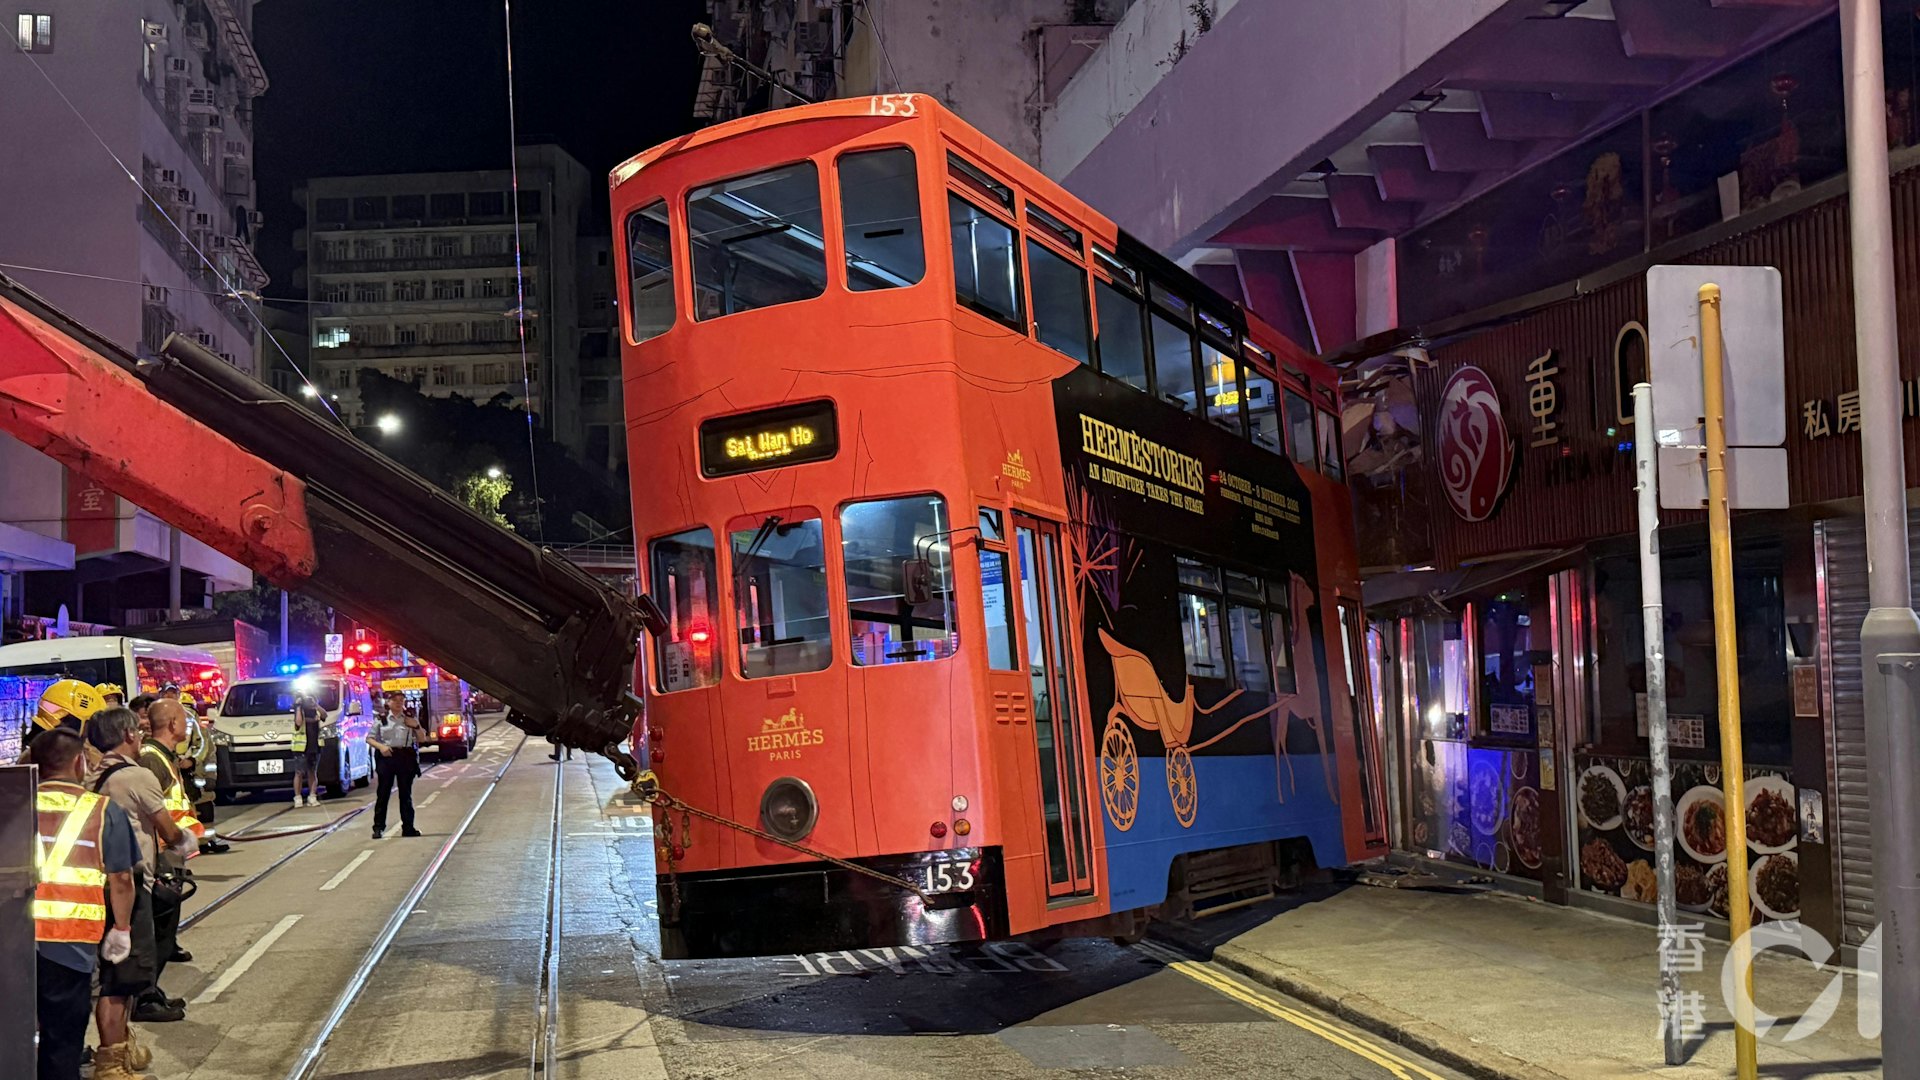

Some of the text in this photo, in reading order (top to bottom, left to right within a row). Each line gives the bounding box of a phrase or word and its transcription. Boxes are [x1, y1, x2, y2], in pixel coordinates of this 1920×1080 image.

[870, 93, 916, 117] 153
[726, 437, 754, 457] Sai
[758, 433, 787, 451] Wan
[790, 426, 814, 445] Ho
[78, 482, 105, 511] 室
[1088, 461, 1100, 481] AN
[1101, 466, 1146, 496] ADVENTURE
[1145, 481, 1169, 504] TAKES
[1169, 490, 1184, 508] THE
[1184, 495, 1205, 516] STAGE
[747, 728, 824, 752] HERMÈS
[769, 749, 802, 762] PARIS
[926, 862, 974, 892] 153
